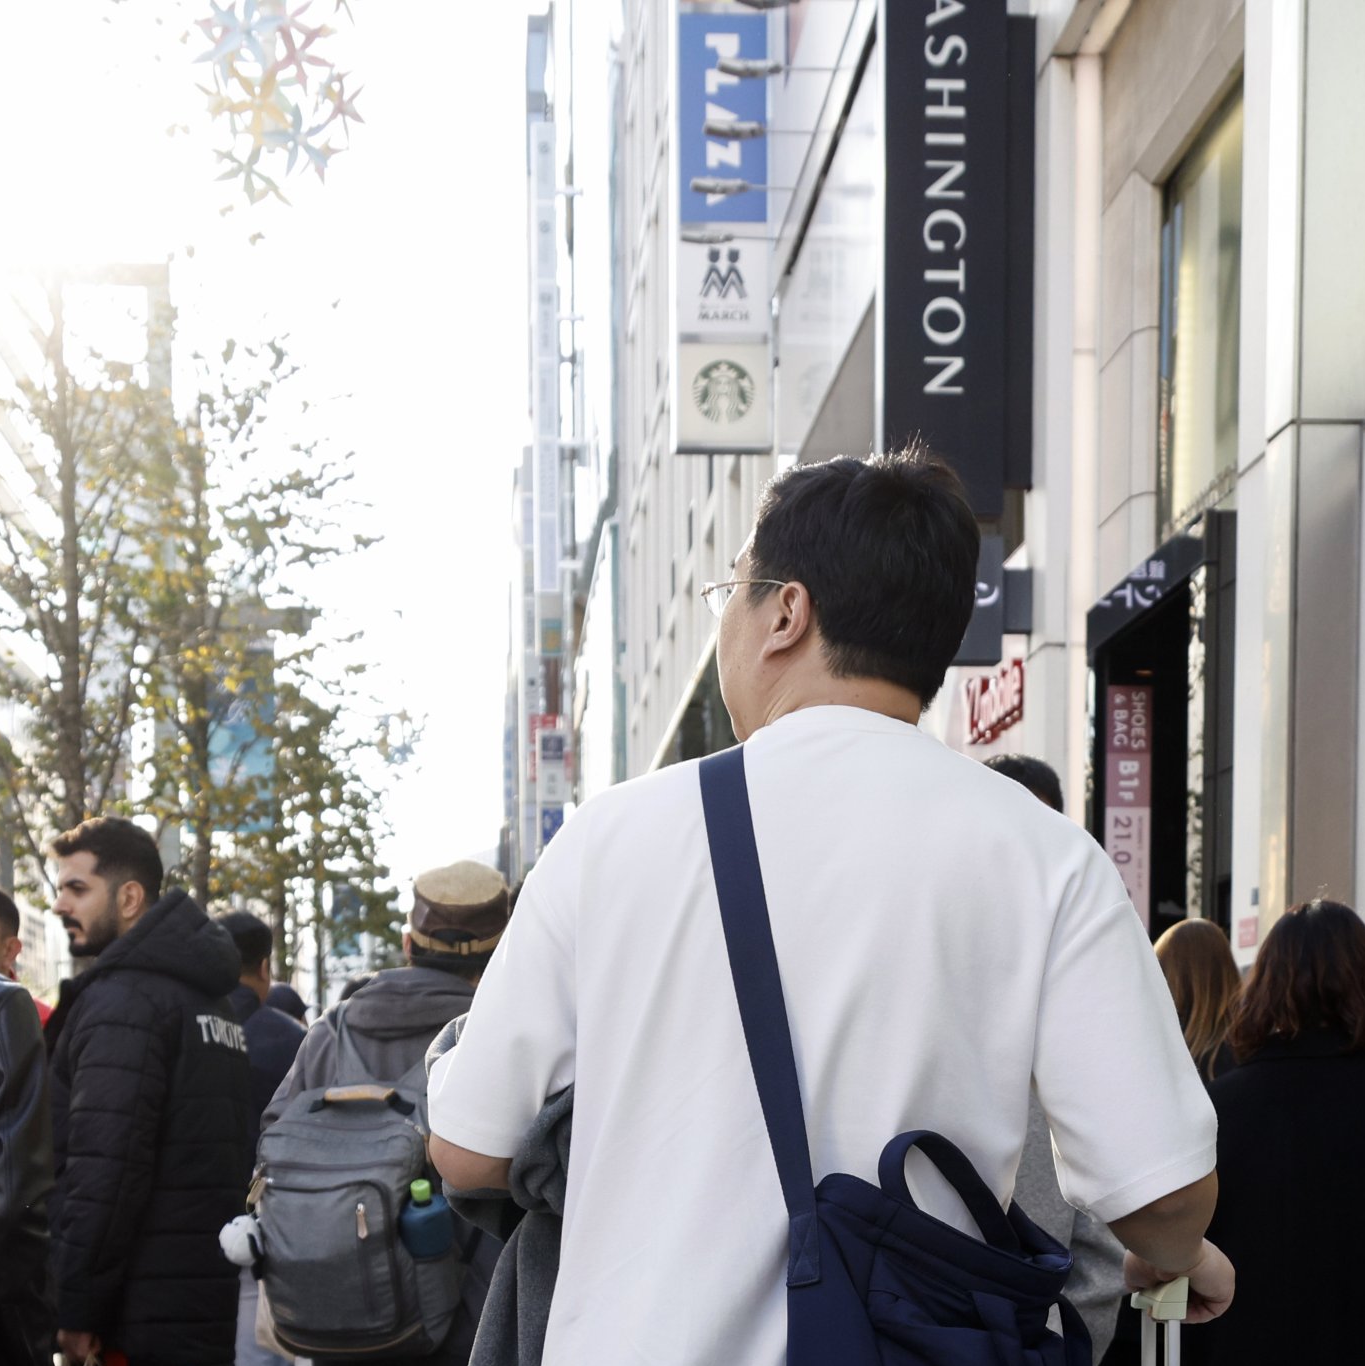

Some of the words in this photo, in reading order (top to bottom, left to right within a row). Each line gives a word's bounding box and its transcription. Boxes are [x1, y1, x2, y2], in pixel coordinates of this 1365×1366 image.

[1113, 709, 1129, 747] BAG
[1131, 691, 1147, 750] SHOES
[1119, 760, 1140, 802] B1F
